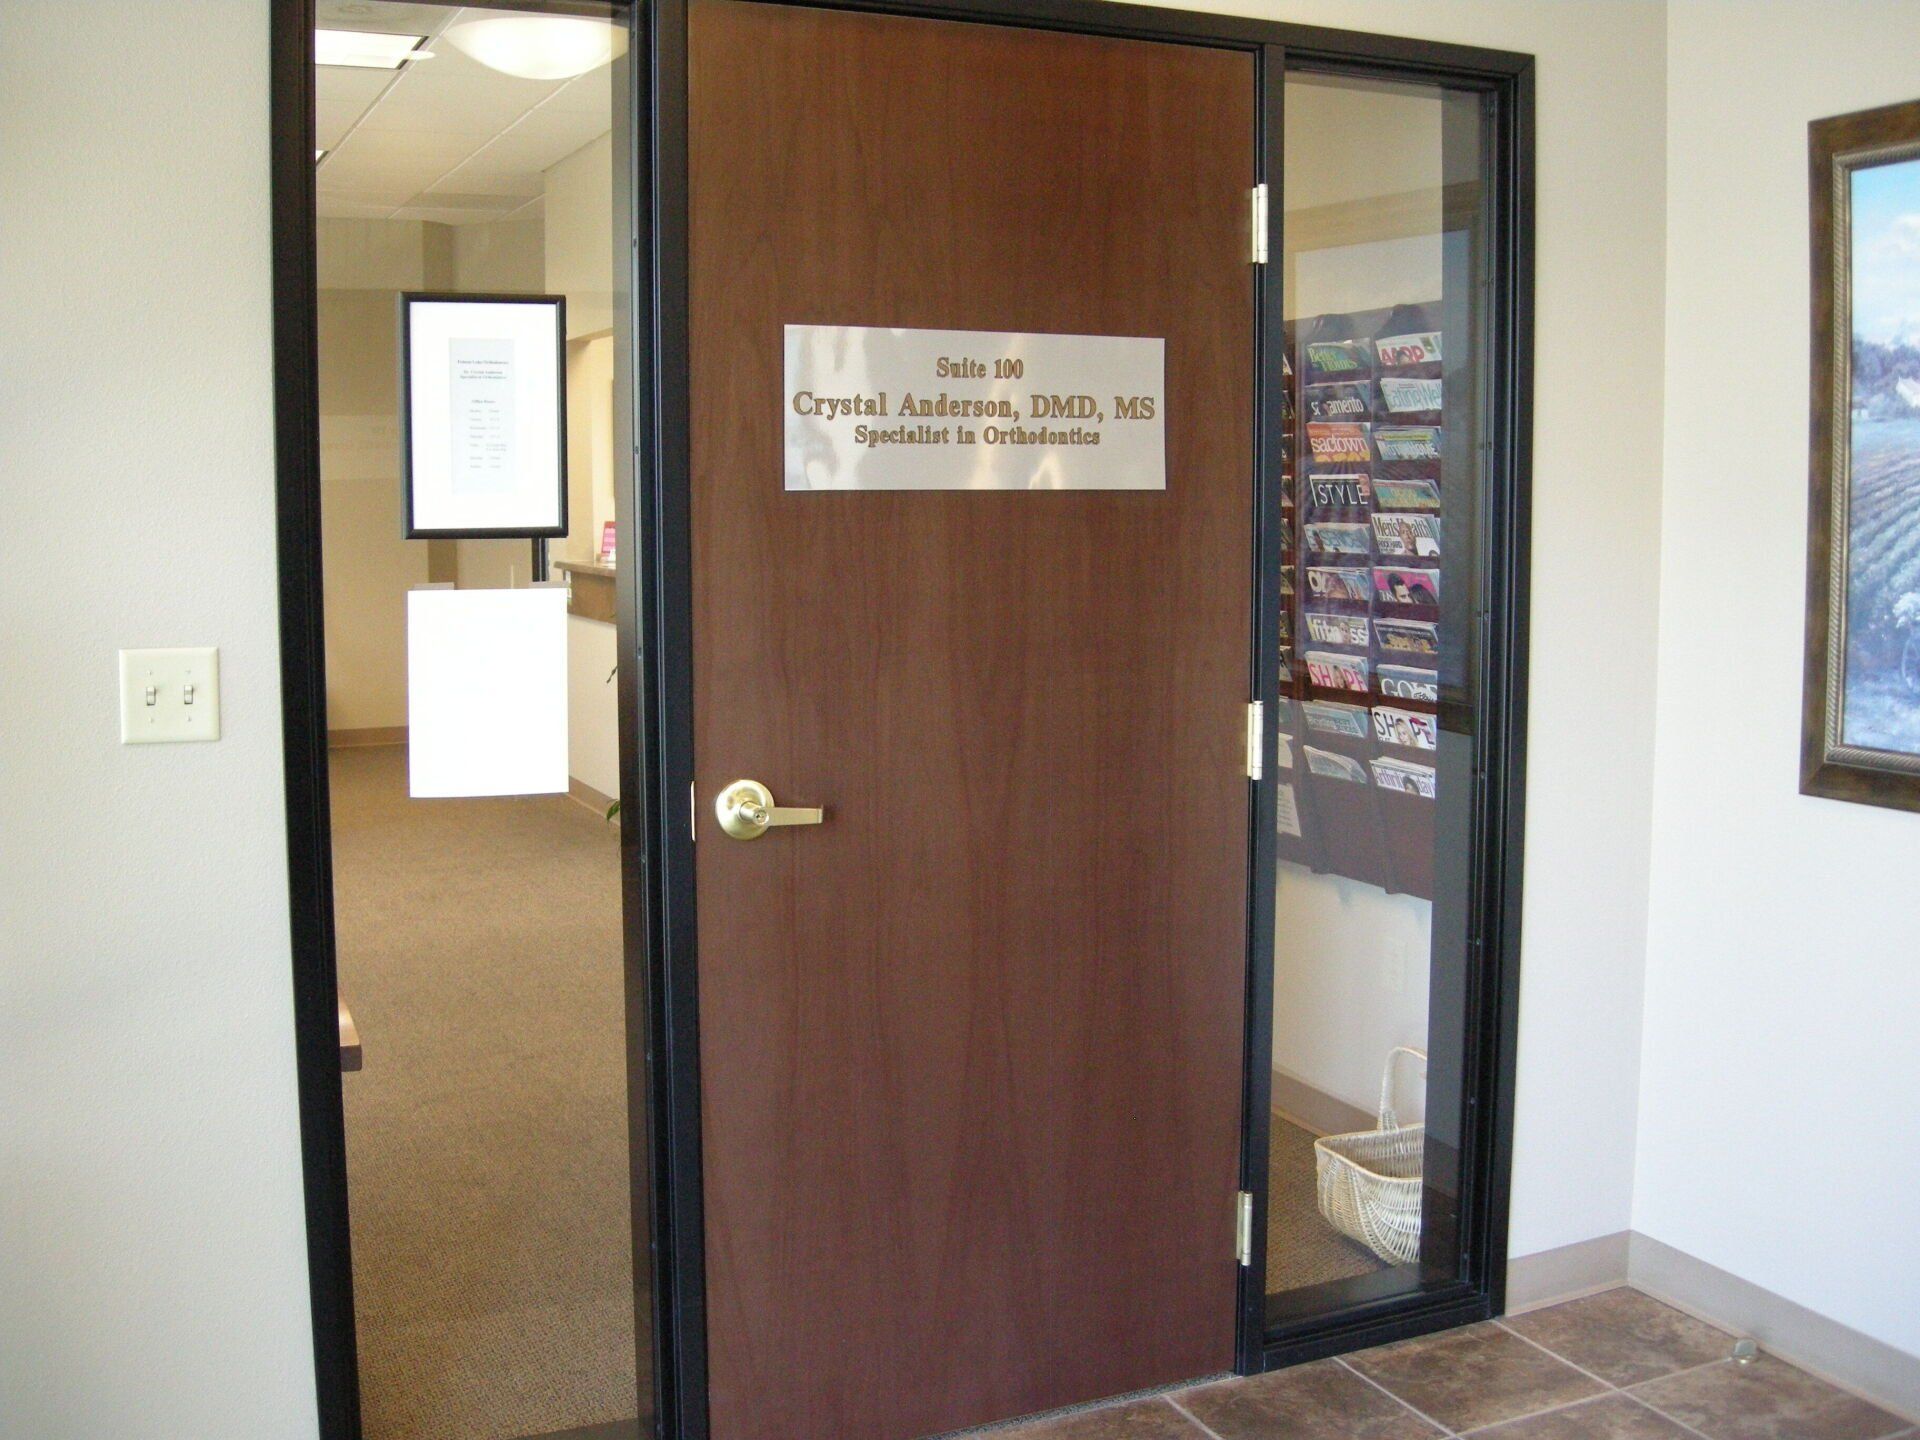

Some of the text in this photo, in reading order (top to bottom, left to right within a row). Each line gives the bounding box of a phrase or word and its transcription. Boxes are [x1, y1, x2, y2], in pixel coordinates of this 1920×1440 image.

[936, 357, 1024, 379] Suite 100
[792, 391, 1156, 423] Crystal Anderson, DMD, MS
[854, 425, 1101, 448] Specialist in Orthodontics
[1318, 484, 1369, 504] STYLE
[1397, 518, 1433, 538] Halth
[1312, 618, 1369, 646] fitnss
[1309, 663, 1365, 692] SHPE
[1374, 711, 1435, 745] SHPE
